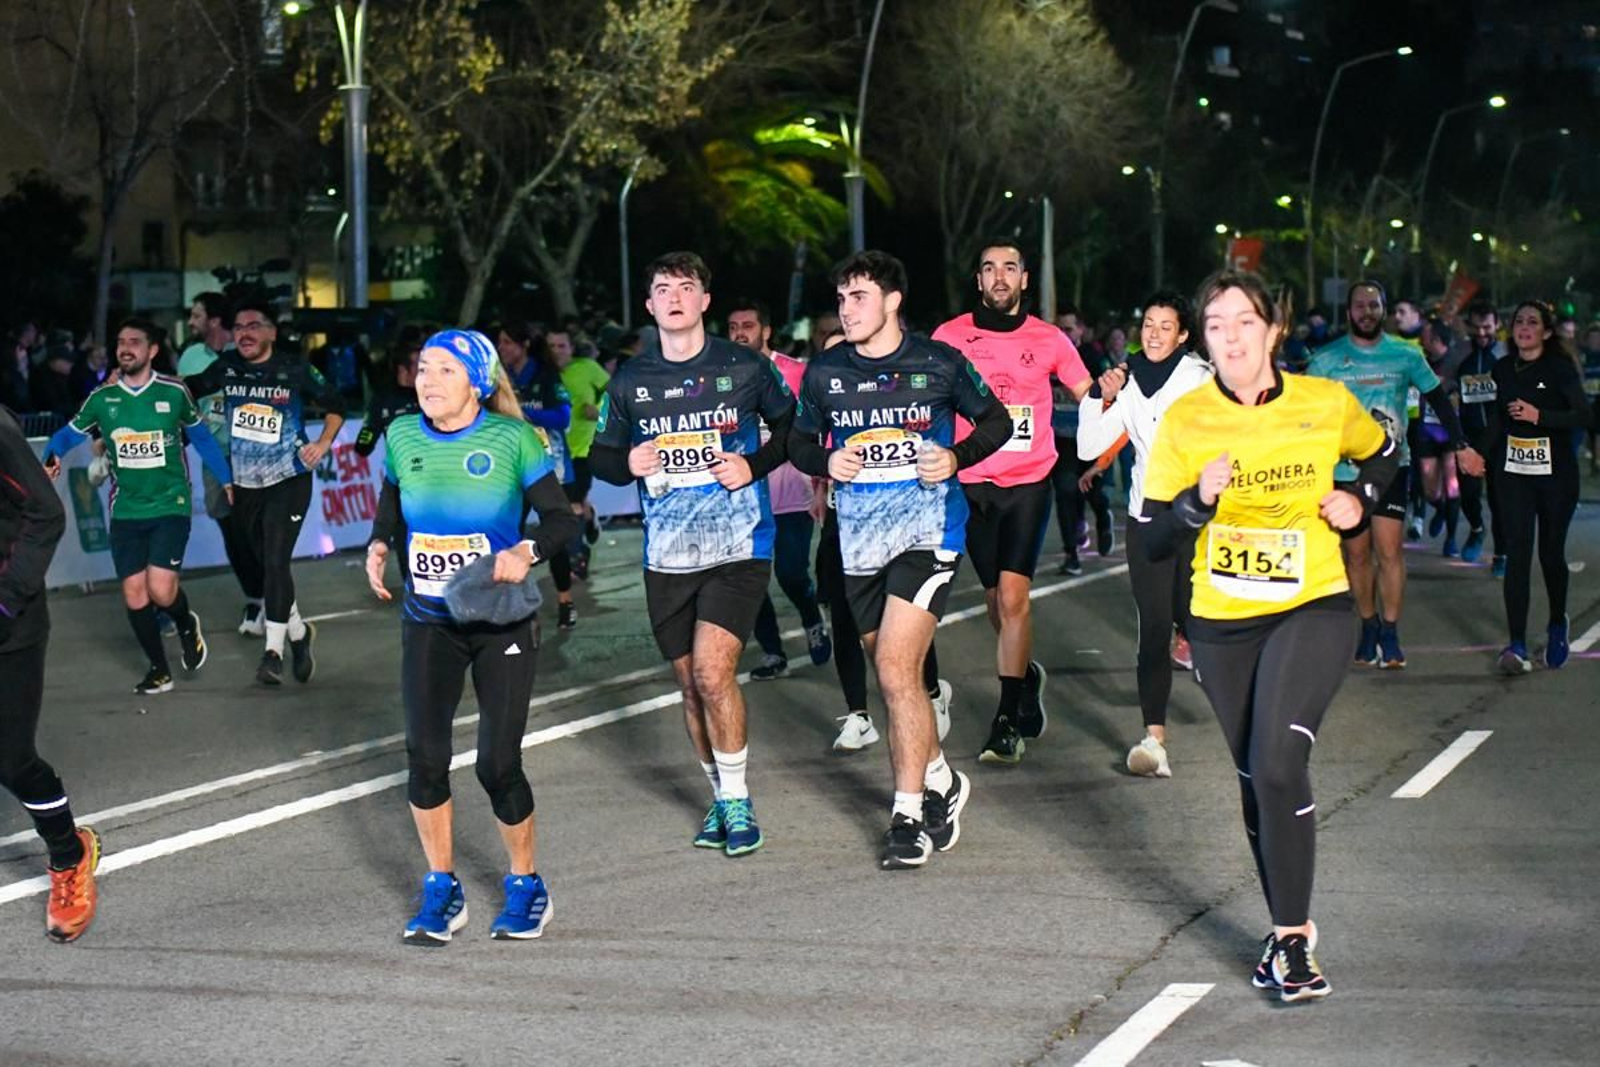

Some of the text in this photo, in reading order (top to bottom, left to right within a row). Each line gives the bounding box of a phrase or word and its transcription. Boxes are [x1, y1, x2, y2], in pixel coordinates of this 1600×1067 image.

[225, 385, 290, 399] SAN ANTÓN
[238, 412, 277, 429] 5016
[639, 402, 738, 435] SAN ANTÓN
[831, 402, 931, 427] SAN ANTÓN
[119, 442, 160, 455] 4566
[658, 446, 715, 467] 9896
[854, 440, 917, 462] 9823
[1510, 447, 1546, 461] 7048
[1217, 546, 1292, 575] 3154
